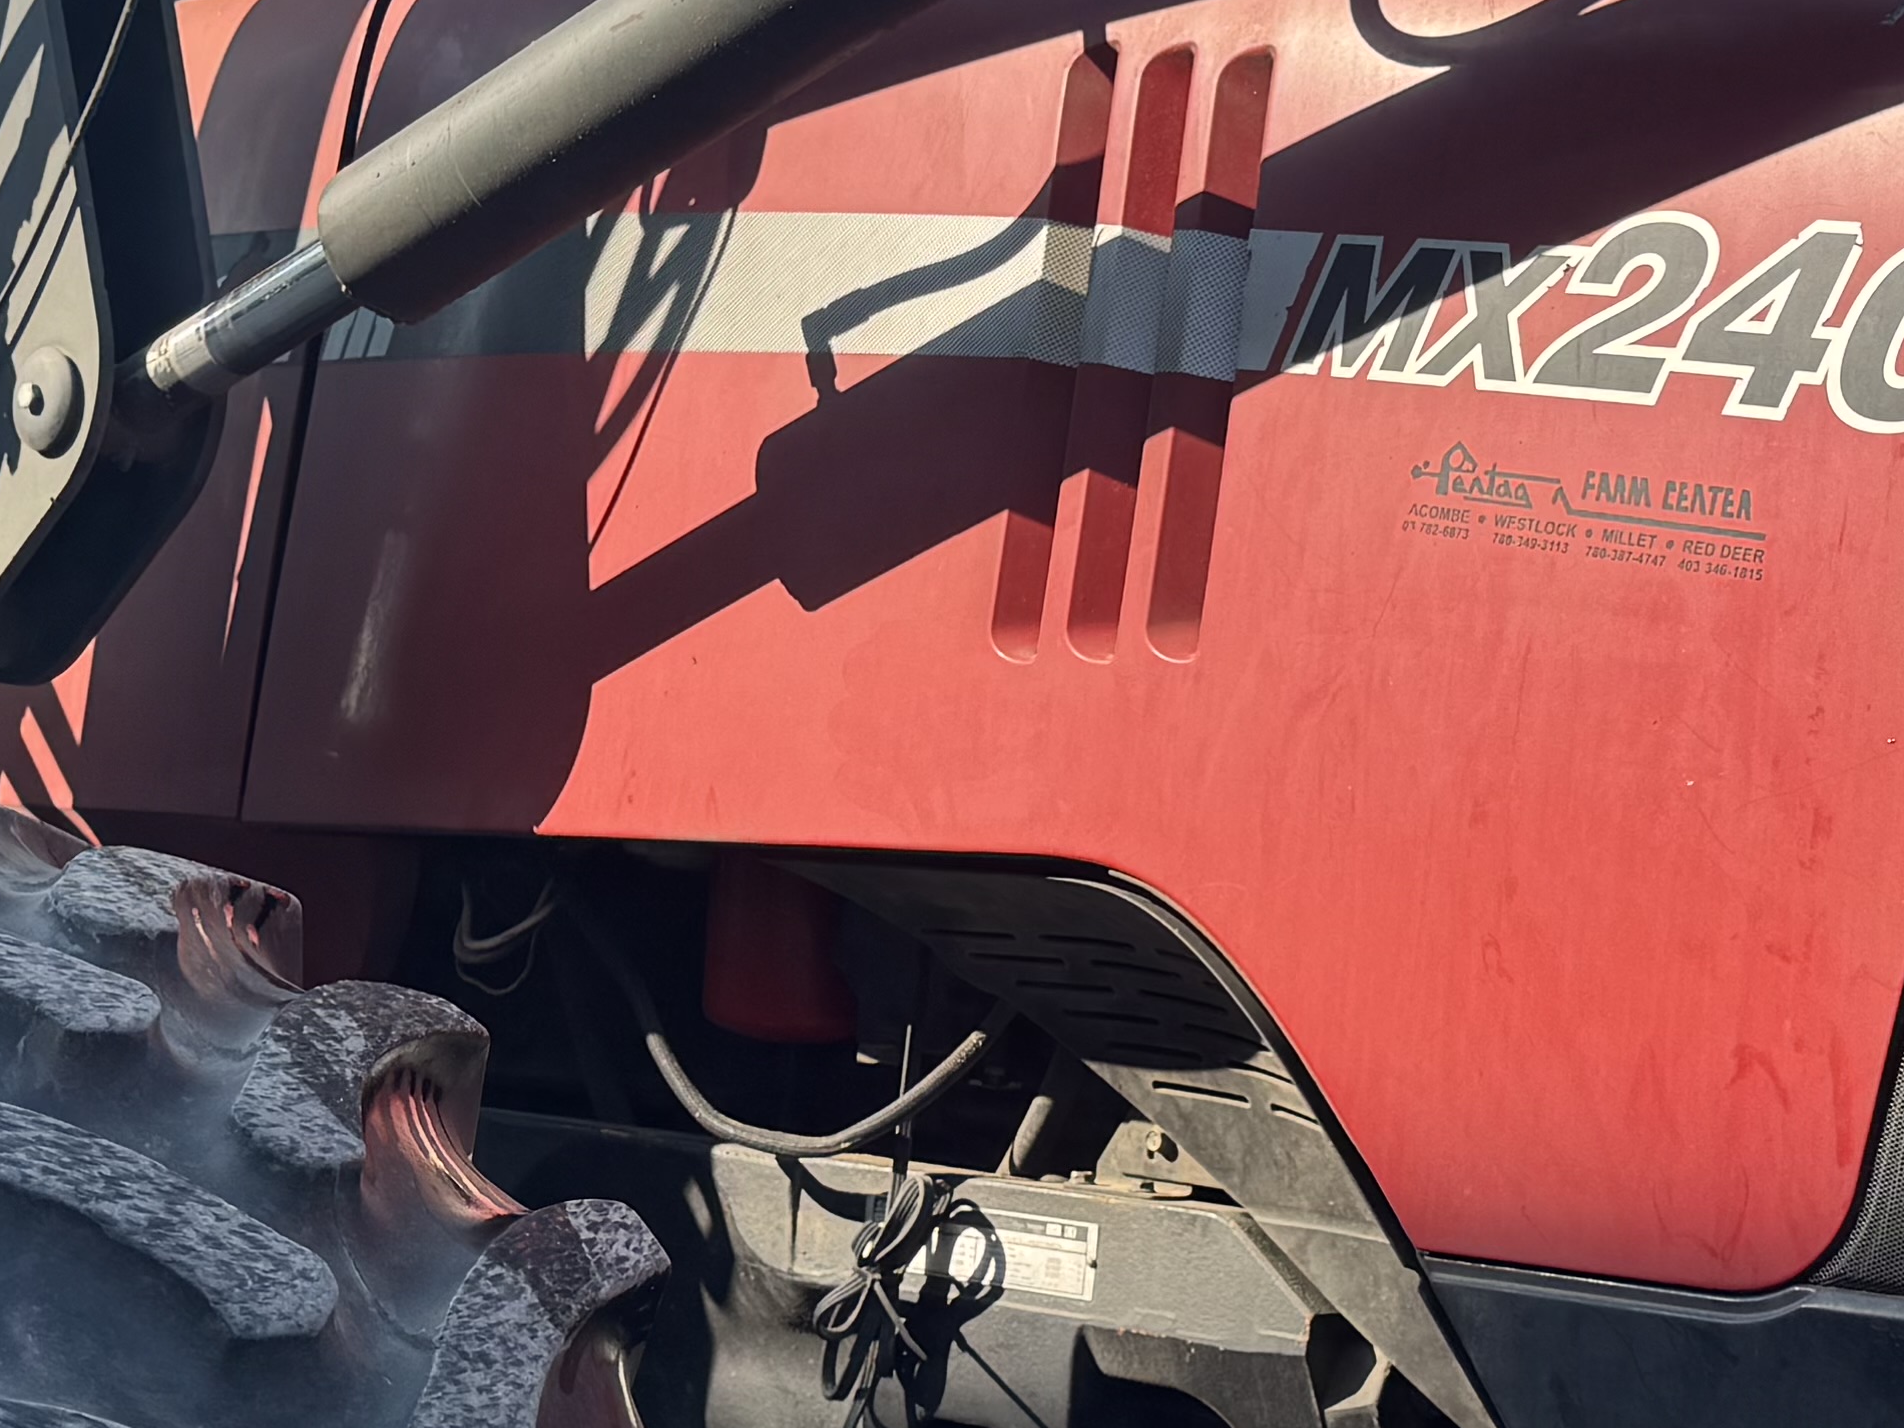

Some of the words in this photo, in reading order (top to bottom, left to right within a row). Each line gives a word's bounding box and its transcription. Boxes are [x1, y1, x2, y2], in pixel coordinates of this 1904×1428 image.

[1494, 513, 1578, 539] WESTLOCK
[1601, 528, 1658, 549] MILLET
[1682, 539, 1716, 557] RED
[1719, 544, 1765, 564] DEER
